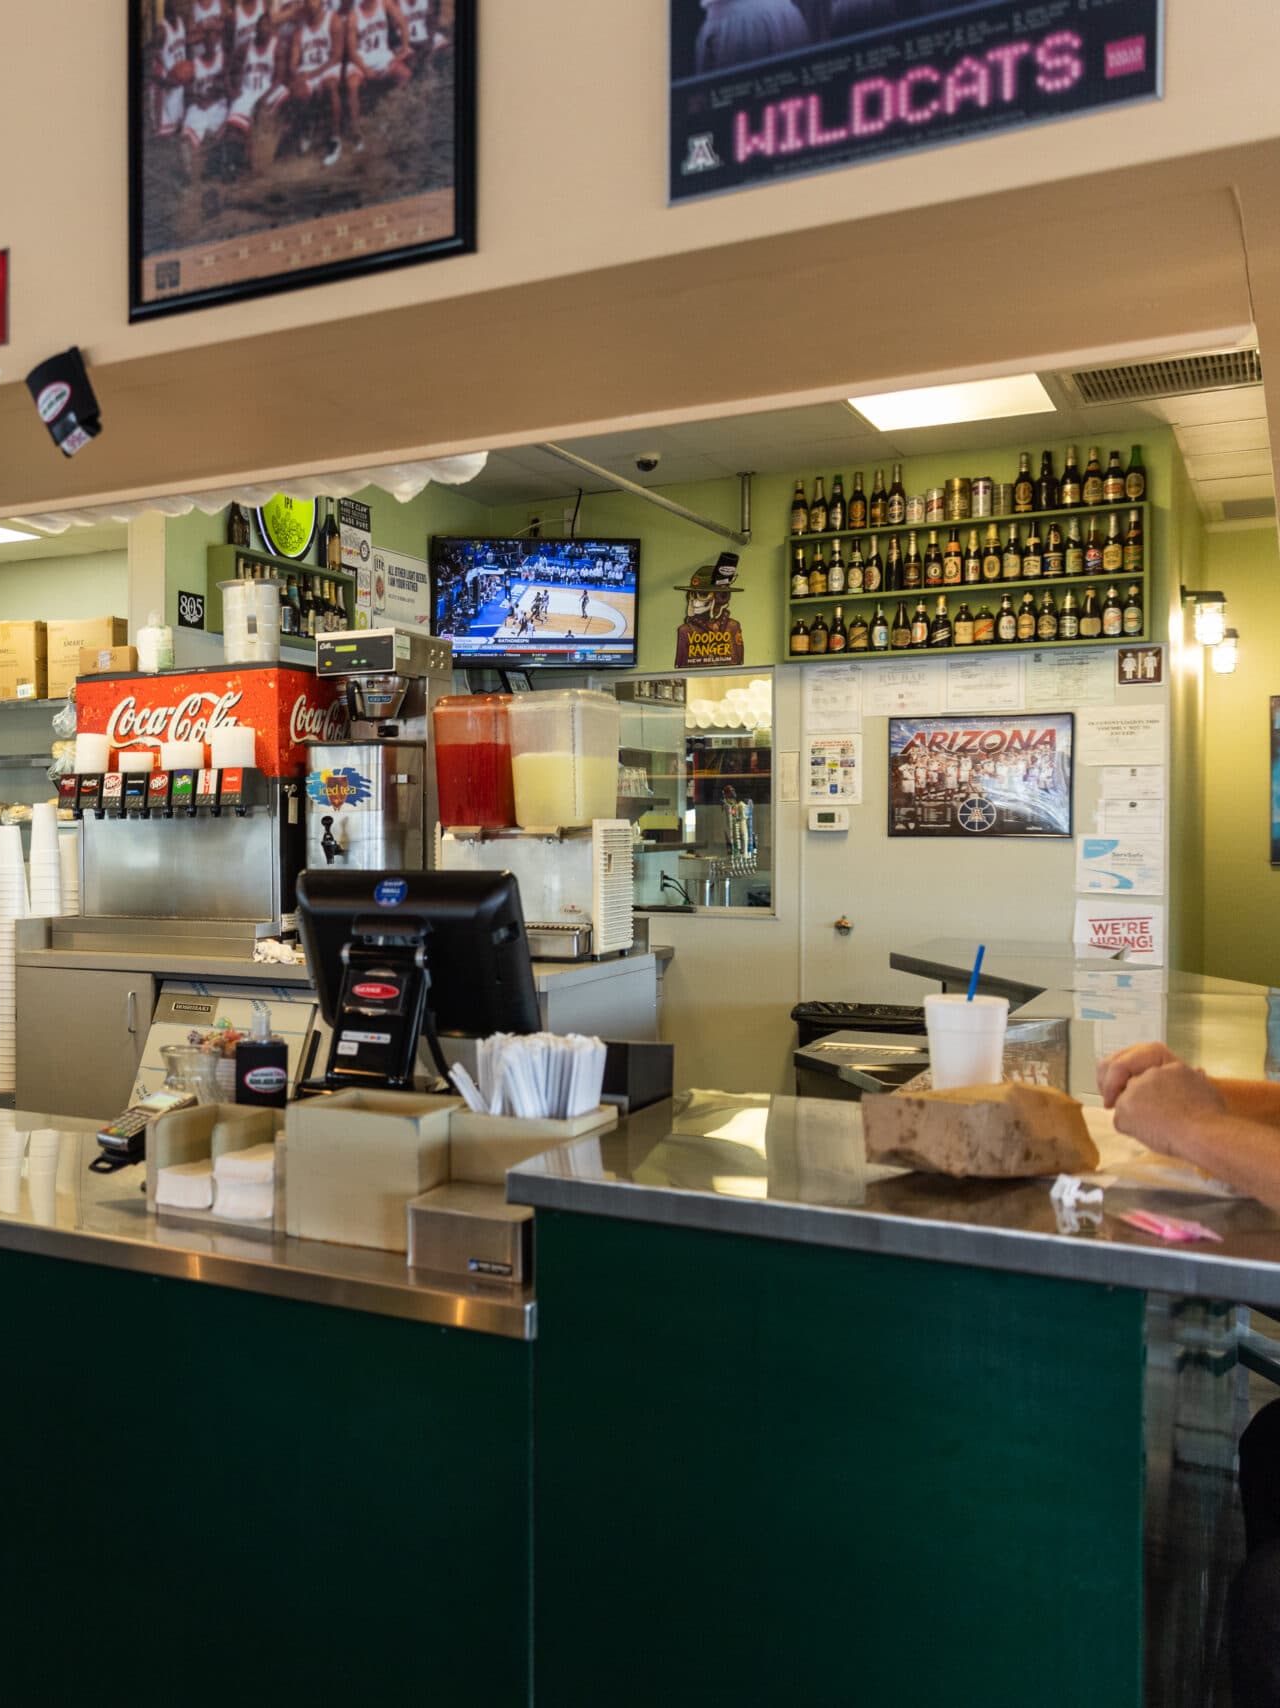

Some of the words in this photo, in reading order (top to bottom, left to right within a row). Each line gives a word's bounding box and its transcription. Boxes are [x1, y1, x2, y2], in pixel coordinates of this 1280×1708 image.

[733, 30, 1083, 164] WILDCATS
[284, 495, 293, 510] IPA
[179, 594, 203, 618] 805
[688, 631, 731, 644] VOODOO
[688, 644, 732, 657] RANGER
[107, 689, 243, 749] Coca-Cola
[898, 728, 1057, 757] ARIZONA
[320, 784, 339, 796] iced
[340, 784, 357, 795] tea
[1091, 921, 1151, 935] WE'RE
